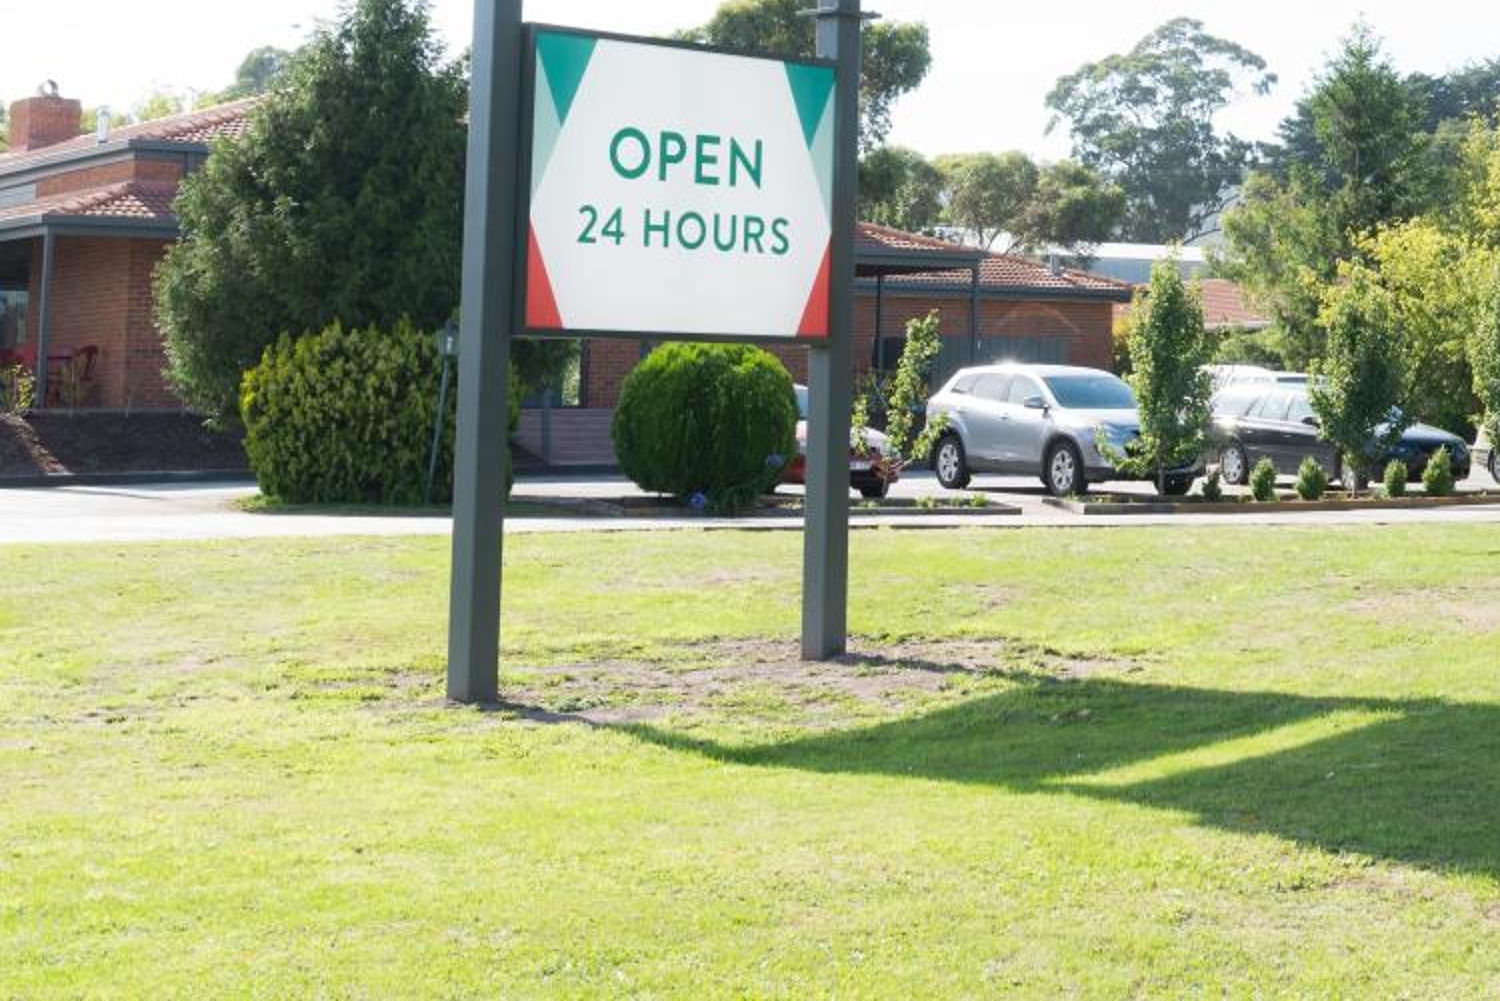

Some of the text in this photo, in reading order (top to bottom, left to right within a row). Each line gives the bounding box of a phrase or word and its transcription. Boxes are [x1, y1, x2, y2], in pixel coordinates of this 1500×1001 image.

[609, 127, 763, 188] OPEN
[577, 205, 790, 255] 24 HOURS
